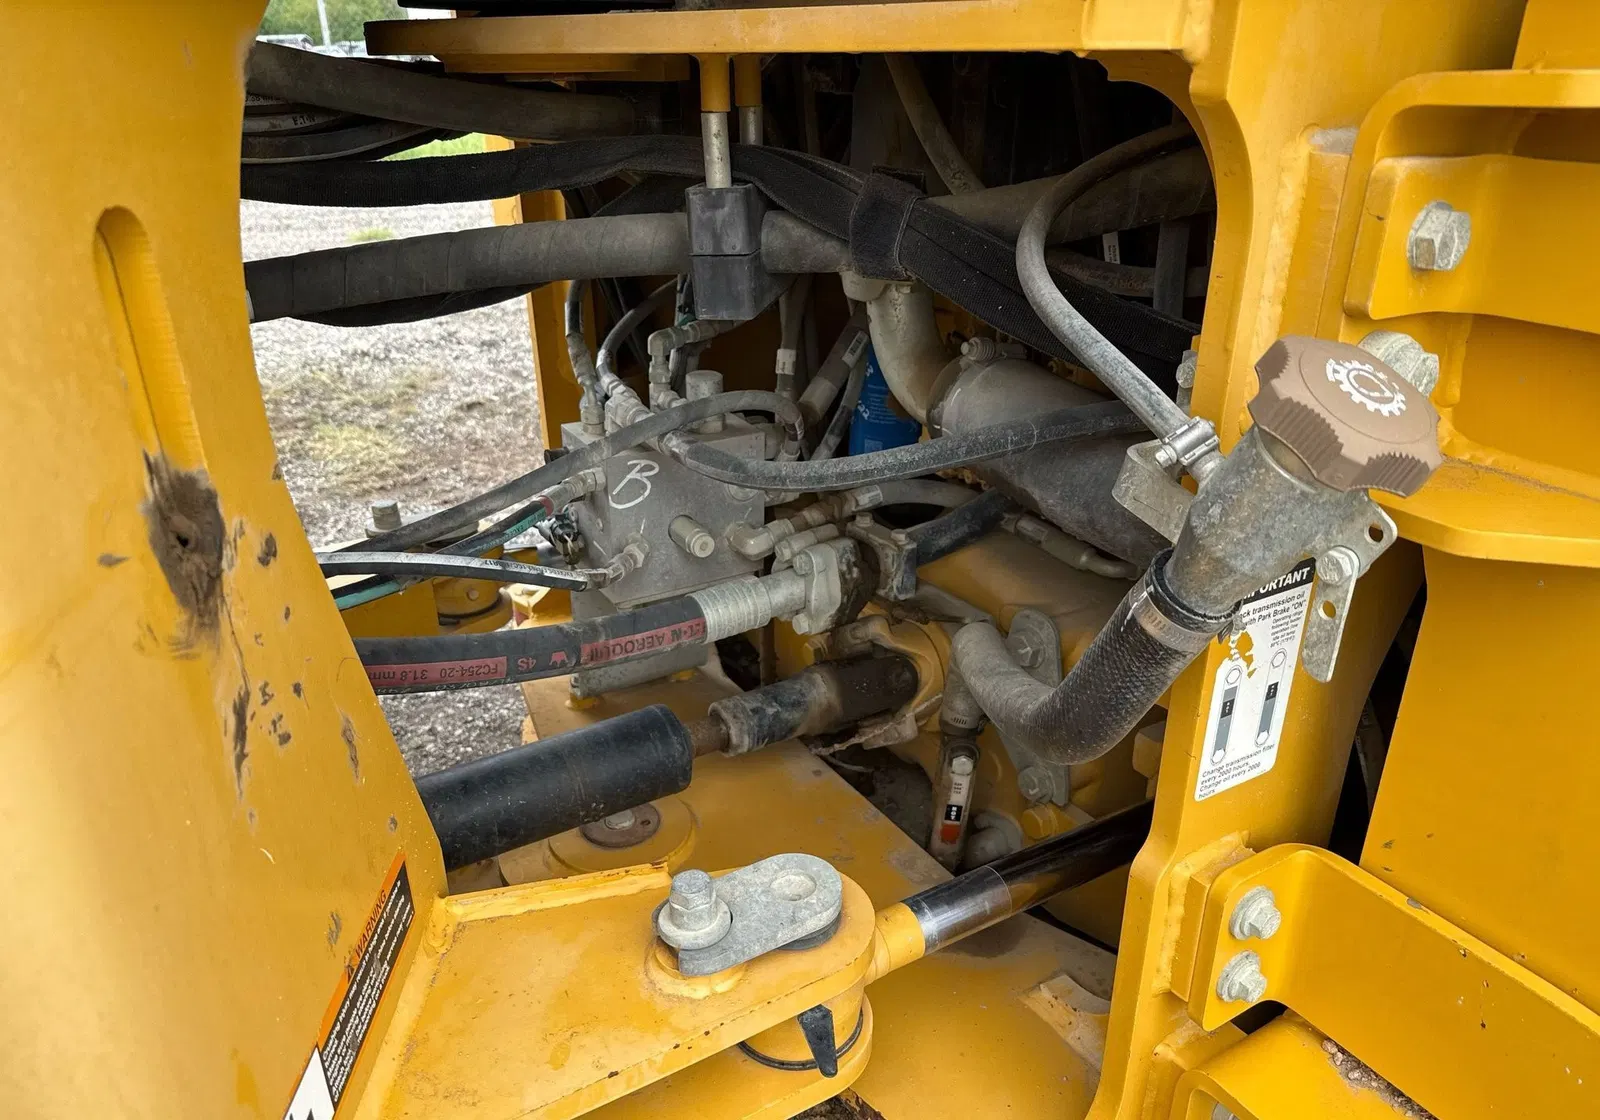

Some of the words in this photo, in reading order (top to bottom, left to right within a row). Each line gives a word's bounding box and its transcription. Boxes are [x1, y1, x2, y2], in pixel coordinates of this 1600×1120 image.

[608, 460, 660, 510] B
[1244, 566, 1310, 599] ORTANT
[1252, 596, 1295, 614] transmission
[1296, 591, 1306, 600] oil
[1258, 612, 1271, 622] Park
[1273, 606, 1290, 618] Brake
[439, 663, 499, 680] FC254-20
[518, 658, 536, 672] 4S
[369, 670, 396, 681] mm
[400, 670, 428, 681] 31.8
[356, 890, 386, 959] WARNING
